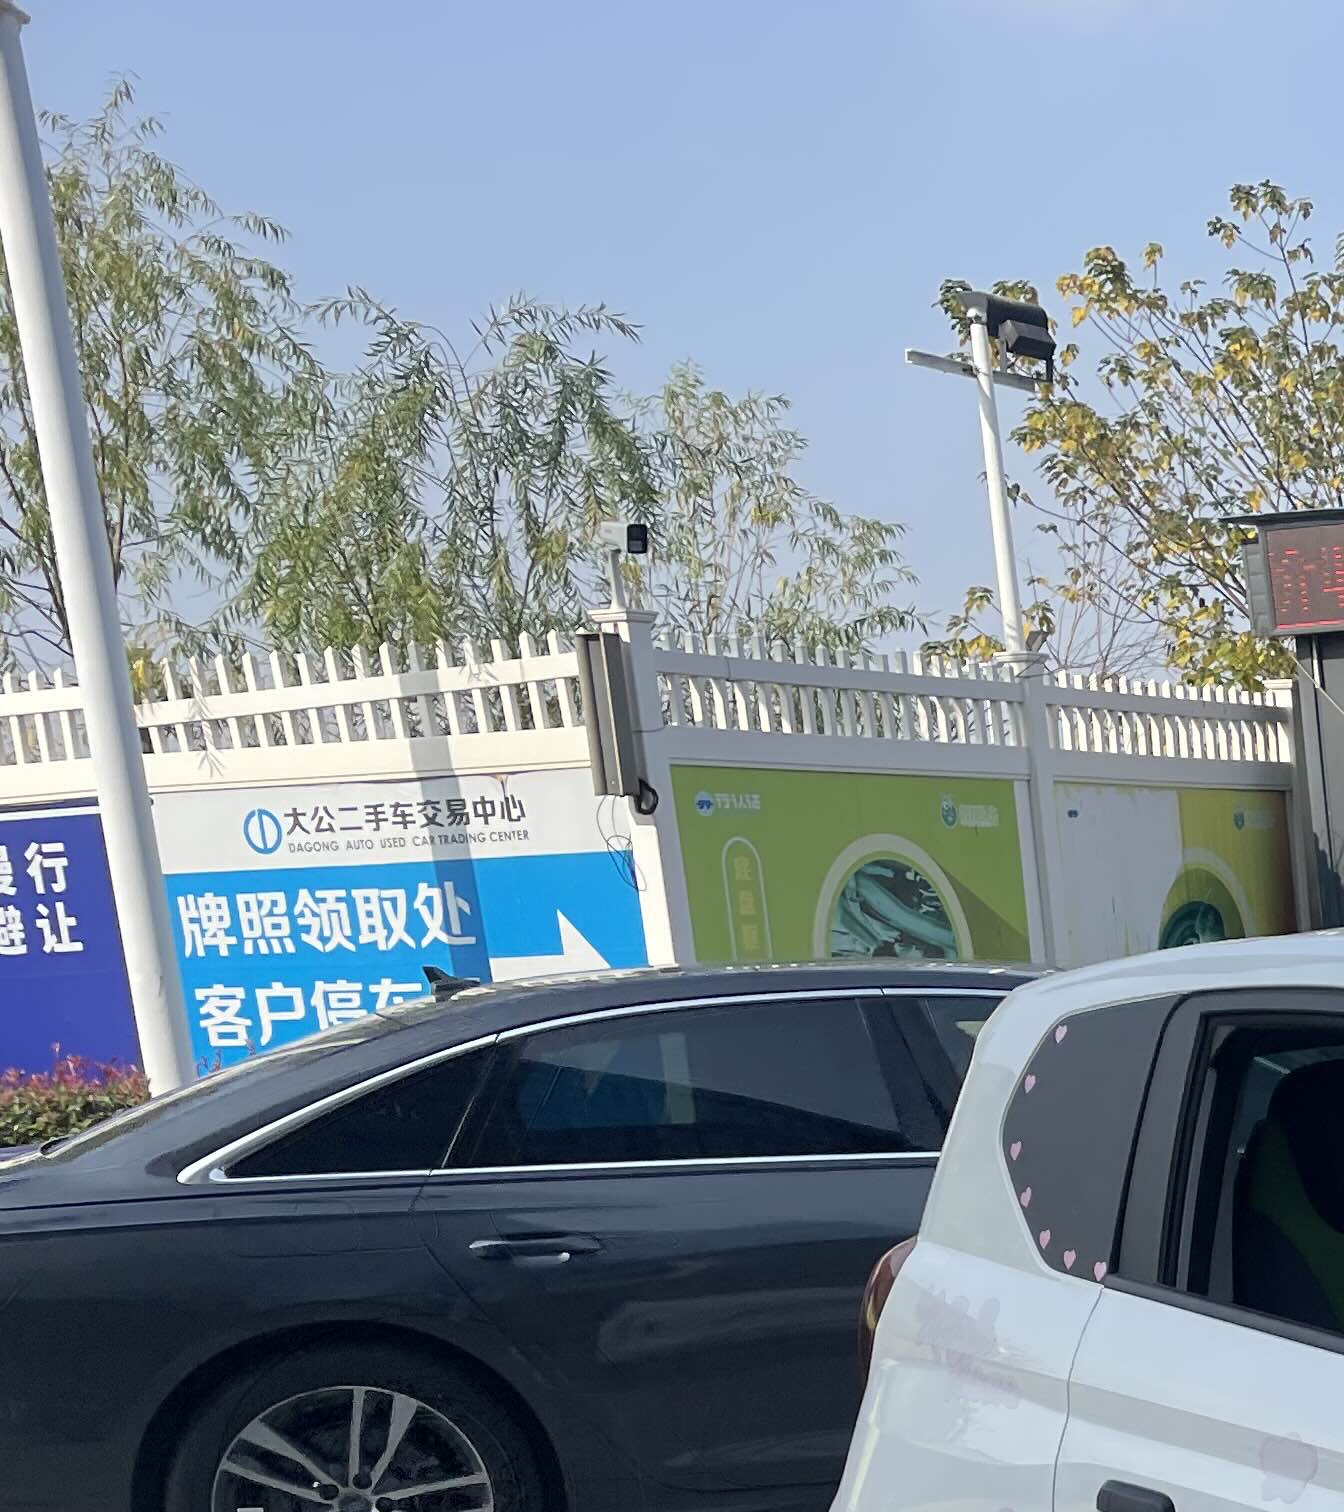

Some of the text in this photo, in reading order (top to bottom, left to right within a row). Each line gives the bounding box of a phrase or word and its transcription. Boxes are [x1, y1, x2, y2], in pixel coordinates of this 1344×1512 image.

[284, 794, 526, 836] 大公二手车交易中心
[288, 829, 530, 854] DAGONG AUTO USED CAR TRADING CENTER
[177, 881, 477, 958] 牌照领取处
[194, 978, 480, 1047] 客户停
